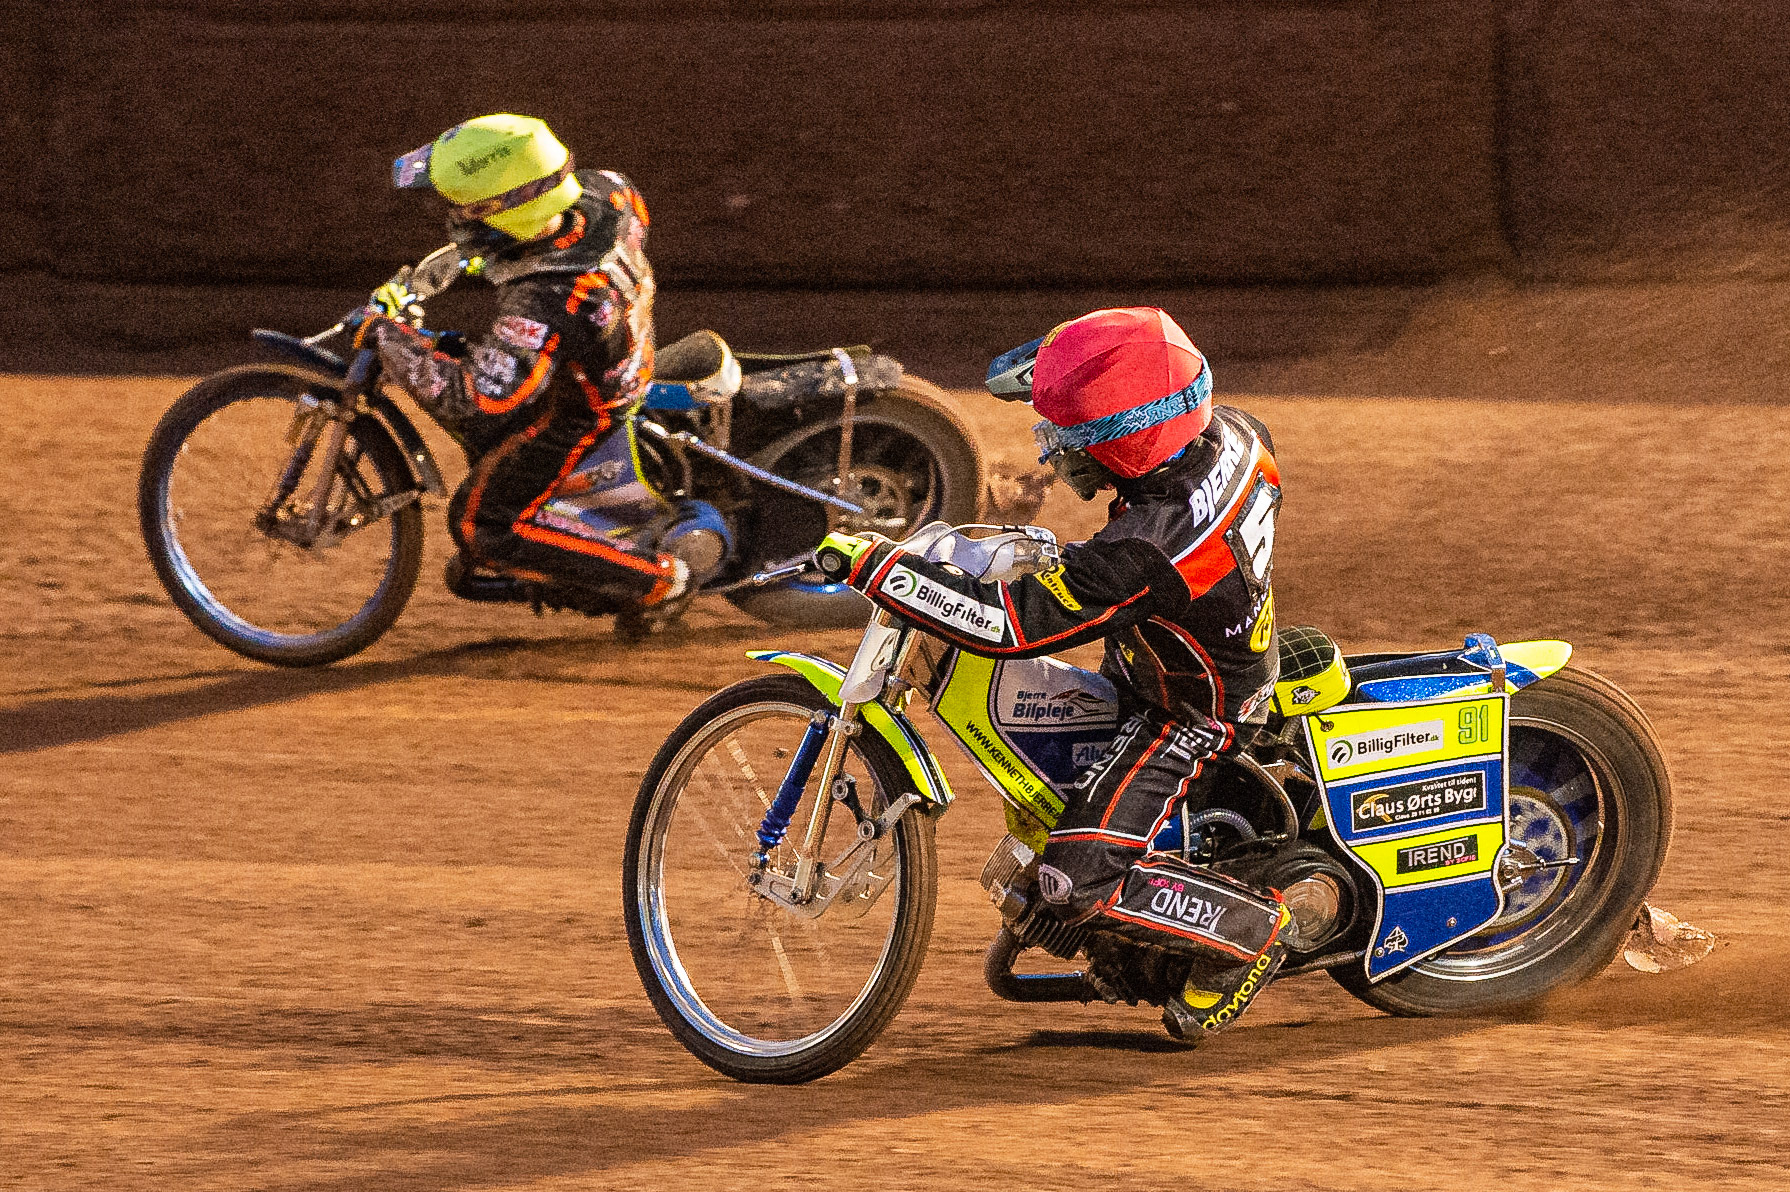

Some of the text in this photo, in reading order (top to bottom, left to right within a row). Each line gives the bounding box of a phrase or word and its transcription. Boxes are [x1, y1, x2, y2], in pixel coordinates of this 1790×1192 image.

[1239, 486, 1276, 580] 5
[1016, 690, 1048, 701] Bjerre
[1011, 702, 1075, 721] Bilpleje
[1459, 704, 1489, 744] 91
[1358, 799, 1405, 820] Claus
[1407, 793, 1442, 811] Ørts
